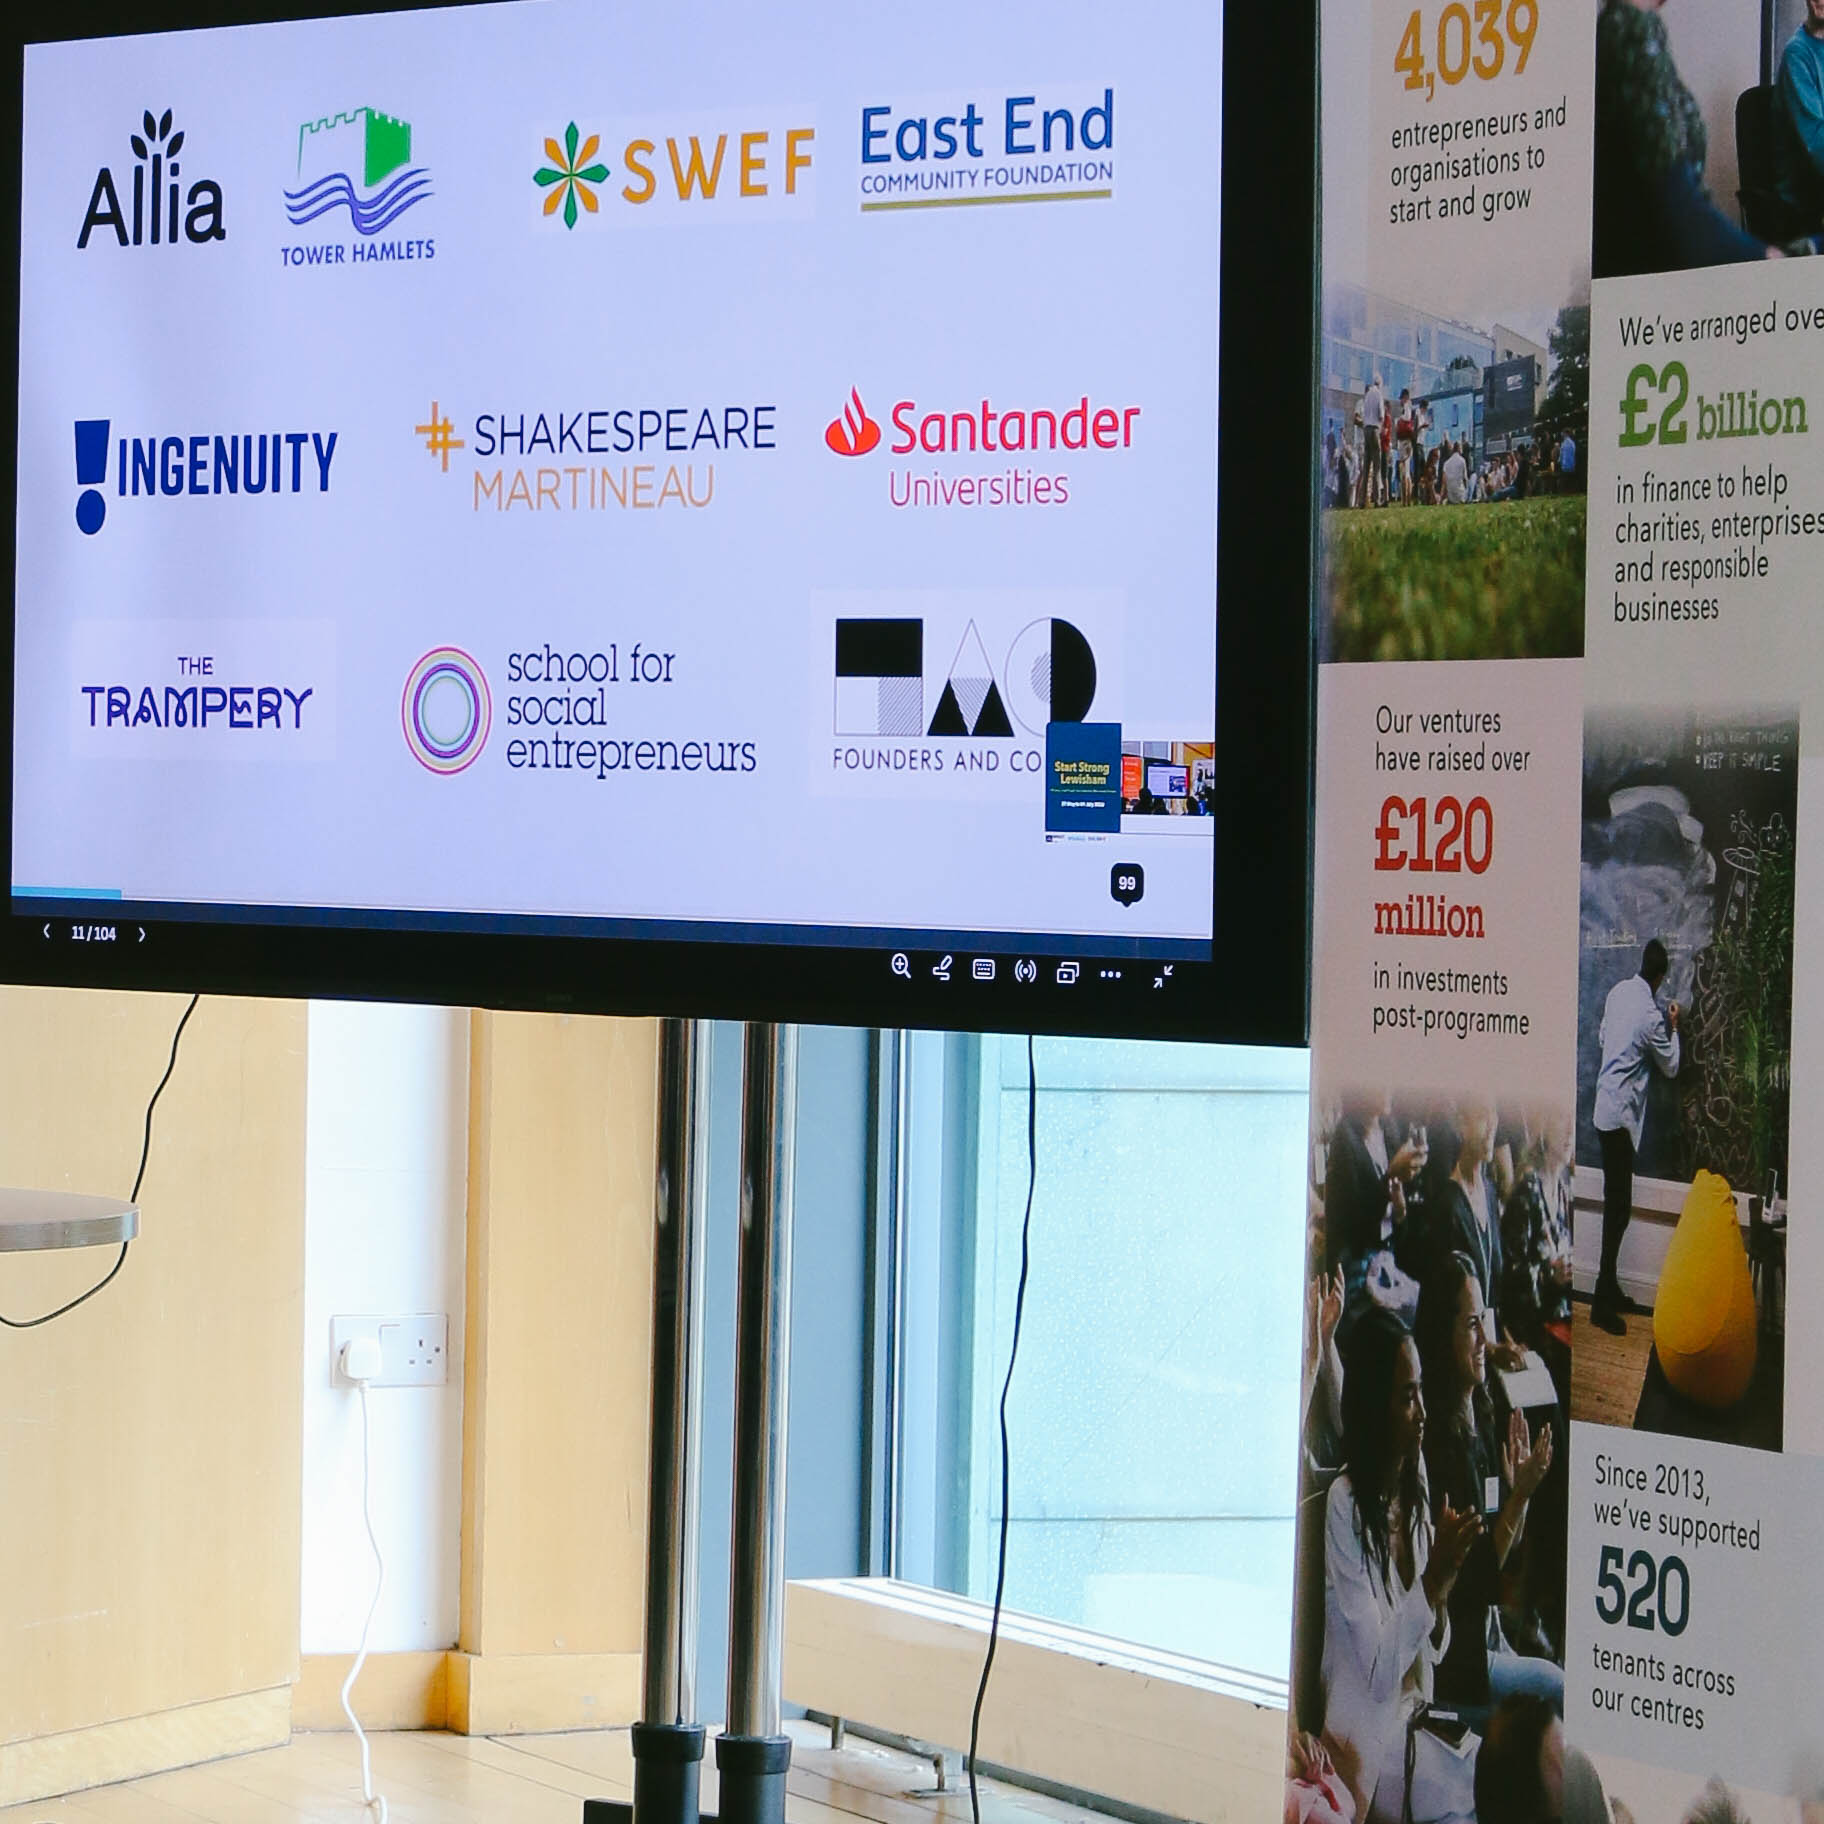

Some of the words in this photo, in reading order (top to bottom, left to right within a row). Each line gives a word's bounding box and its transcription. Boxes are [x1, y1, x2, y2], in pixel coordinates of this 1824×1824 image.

[861, 103, 984, 165] East
[1003, 88, 1114, 154] End
[1391, 115, 1529, 152] entrepreneurs
[1534, 96, 1567, 130] and
[622, 128, 815, 204] SWEF
[861, 168, 977, 195] COMMUNITY
[982, 161, 1114, 188] FOUNDATION
[1391, 147, 1521, 193] organisations
[1526, 146, 1545, 169] to
[76, 153, 227, 249] Allia
[1390, 196, 1432, 224] start
[1438, 185, 1475, 218] and
[1482, 188, 1531, 222] grow
[281, 245, 345, 267] TOWER
[352, 239, 436, 263] HAMLETS
[1619, 315, 1684, 347] We've
[1690, 301, 1777, 345] arranged
[1785, 306, 1824, 332] ove
[890, 396, 1142, 454] Santander
[1618, 360, 1690, 448] £2
[1696, 389, 1809, 441] billion
[475, 406, 777, 456] SHAKESPEARE
[118, 432, 339, 496] INGENUITY
[1617, 475, 1634, 504] in
[1642, 471, 1712, 503] finance
[1717, 473, 1736, 499] to
[1742, 463, 1788, 504] help
[474, 464, 715, 512] MARTINEAU
[889, 468, 1070, 507] Universities
[1615, 512, 1706, 546] charities,
[1614, 550, 1654, 584] and
[1661, 545, 1769, 589] responsible
[1613, 591, 1720, 623] businesses
[177, 657, 215, 676] THE
[507, 643, 620, 682] school
[630, 642, 677, 683] for
[81, 687, 314, 729] TRAMPERY
[507, 687, 607, 726] social
[1375, 705, 1414, 734] Our
[1421, 709, 1503, 733] ventures
[506, 731, 758, 780] entrepreneurs
[833, 747, 946, 772] FOUNDERS
[954, 748, 1001, 772] AND
[1054, 760, 1077, 773] Start
[1078, 761, 1111, 776] Strong
[1375, 742, 1421, 771] have
[1428, 742, 1486, 772] raised
[1492, 750, 1531, 771] over
[1060, 773, 1107, 785] Lewisham
[1374, 795, 1494, 875] £120
[1118, 876, 1136, 890] 99
[1374, 894, 1486, 938] million
[1374, 961, 1390, 989] in
[1398, 962, 1509, 996] investments
[1373, 1005, 1530, 1040] post-programme
[1595, 1455, 1647, 1491] Since
[1655, 1464, 1710, 1507] 2013,
[1594, 1498, 1651, 1531] we've
[1658, 1513, 1761, 1551] supported
[1595, 1545, 1690, 1638] 520
[1593, 1643, 1665, 1682] tenants
[1672, 1663, 1736, 1697] across
[1592, 1687, 1624, 1713] our
[1630, 1694, 1705, 1731] centres
